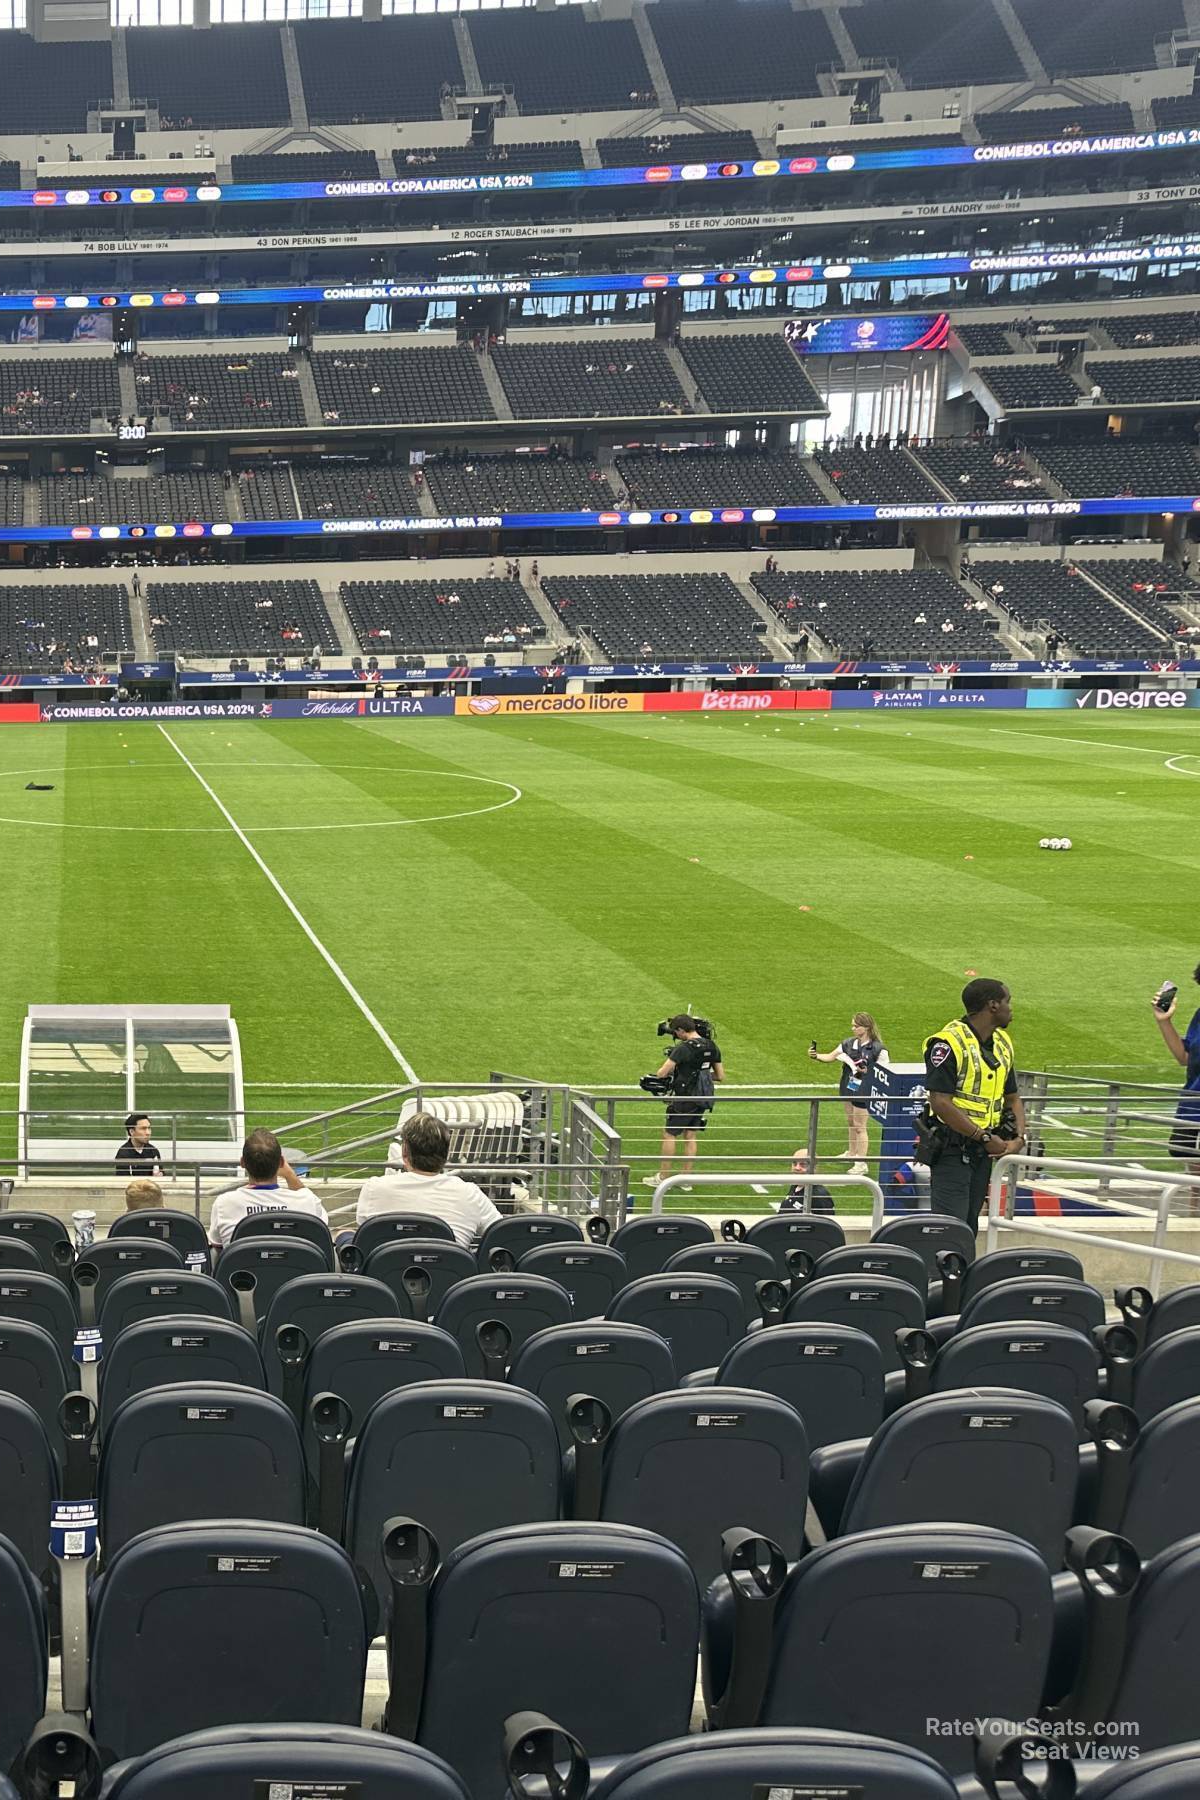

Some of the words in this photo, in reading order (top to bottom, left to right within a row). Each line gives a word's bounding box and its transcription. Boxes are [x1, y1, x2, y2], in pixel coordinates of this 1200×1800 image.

[974, 146, 1051, 161] CONMEBOL
[1052, 140, 1090, 155] COPA
[1089, 137, 1155, 153] AMERICA
[1158, 133, 1186, 146] USA
[325, 183, 391, 196] CONMEBOL
[391, 181, 426, 193] COPA
[425, 179, 477, 192] AMERICA
[479, 177, 503, 189] USA
[504, 175, 533, 187] 2024
[1137, 191, 1150, 201] 33
[1154, 189, 1185, 199] TONY
[917, 206, 939, 215] TOM
[942, 203, 983, 215] LANDRY
[669, 220, 680, 229] 55
[685, 219, 701, 228] LEE
[703, 218, 720, 227] ROY
[723, 216, 760, 226] JORDAN
[257, 238, 268, 247] 43
[272, 237, 289, 246] DON
[292, 236, 327, 246] PERKINS
[450, 231, 460, 240] 12
[464, 230, 494, 239] ROGER
[495, 228, 538, 237] STAUBACH
[83, 244, 94, 252] 74
[98, 243, 116, 251] BOB
[118, 242, 138, 251] LILLY
[969, 258, 1047, 271] CONMEBOL
[1049, 254, 1088, 267] COPA
[1087, 250, 1151, 264] AMERICA
[1154, 246, 1183, 258] USA
[323, 288, 388, 300] CONMEBOL
[389, 286, 423, 297] COPA
[422, 284, 475, 296] AMERICA
[477, 283, 501, 293] USA
[501, 281, 530, 293] 2024
[118, 425, 146, 440] 30:00
[875, 507, 940, 519] CONMEBOL
[940, 505, 972, 517] COPA
[971, 504, 1024, 516] AMERICA
[1026, 503, 1049, 515] USA
[1051, 502, 1080, 513] 2024
[322, 521, 378, 532] CONMEBOL
[379, 520, 408, 530] COPA
[407, 518, 454, 529] AMERICA
[456, 517, 475, 528] USA
[477, 516, 502, 527] 2024
[506, 696, 586, 711] mercado
[589, 694, 628, 710] libre
[701, 691, 772, 710] Betano
[885, 693, 922, 701] LATAM
[950, 694, 985, 702] DELTA
[1096, 688, 1187, 709] Degree
[54, 706, 118, 718] CONMEBOL
[119, 706, 151, 717] COPA
[150, 705, 201, 716] AMERICA
[203, 704, 225, 716] USA
[227, 704, 254, 715] 2024
[301, 701, 357, 716] Michelob
[370, 700, 423, 713] ULTRA
[873, 1066, 890, 1087] TCL
